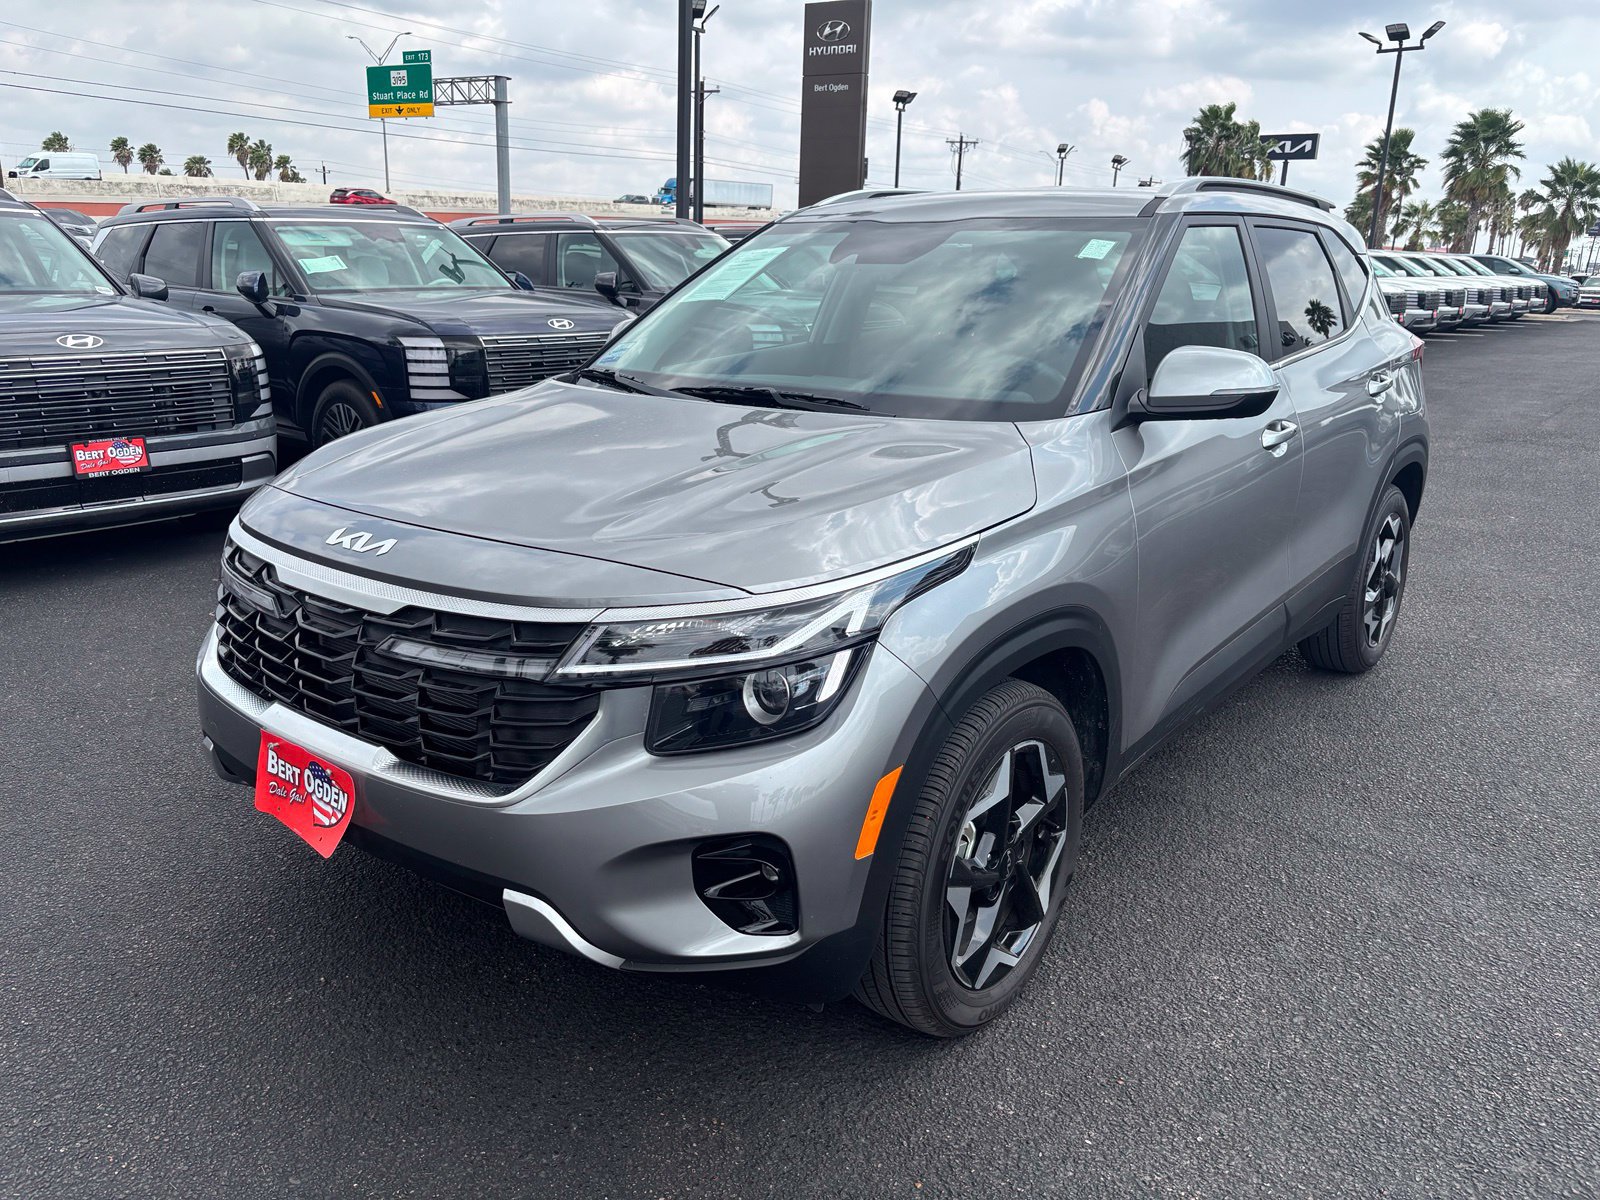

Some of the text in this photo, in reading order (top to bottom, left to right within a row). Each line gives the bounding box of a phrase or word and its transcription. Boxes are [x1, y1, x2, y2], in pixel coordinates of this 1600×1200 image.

[809, 44, 857, 56] HYUNDAI
[418, 53, 429, 61] 173
[392, 75, 407, 86] 3195
[814, 83, 849, 93] Bert Ogden
[372, 90, 429, 101] Stuart Place Rd
[381, 106, 421, 115] EXIT ONLY
[75, 445, 143, 462] BERT OGDEN
[88, 467, 140, 478] BERT OGDEN
[325, 527, 398, 557] KIA
[267, 749, 348, 813] BERT OGDEN
[268, 781, 308, 804] Dale Gas!
